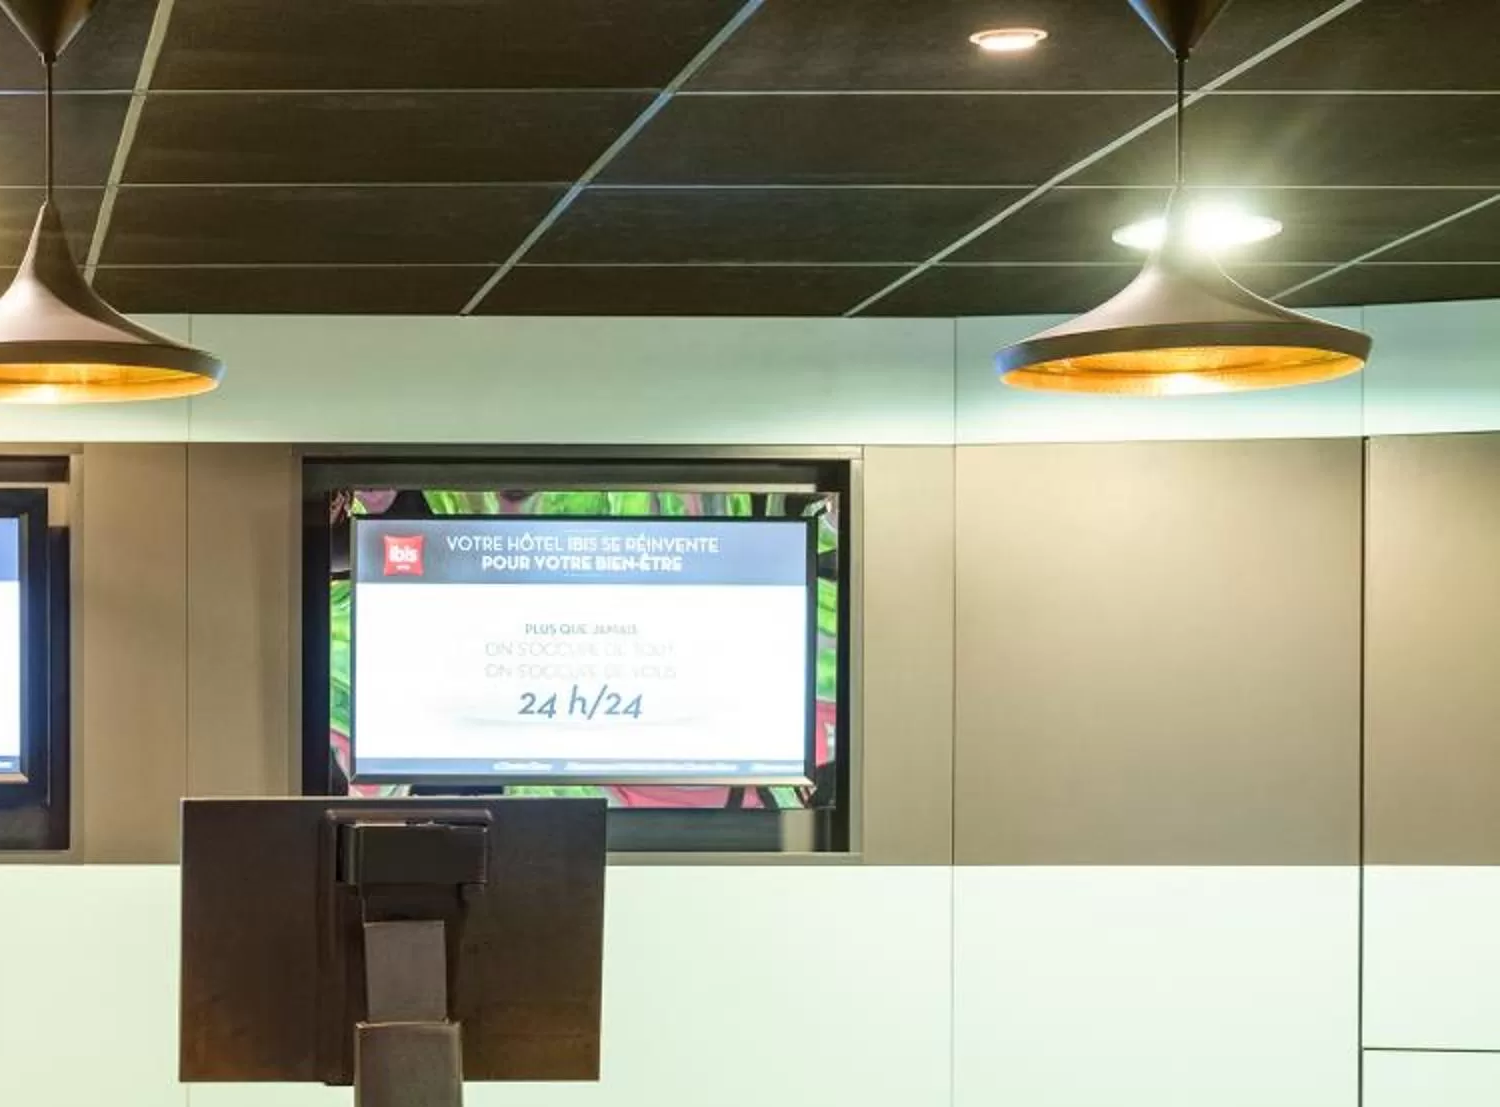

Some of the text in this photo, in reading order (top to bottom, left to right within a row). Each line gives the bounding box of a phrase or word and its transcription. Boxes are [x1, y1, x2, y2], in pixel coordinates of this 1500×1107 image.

[446, 532, 720, 553] VOTRE HÔTEL IBIS SE RÉINVENTE
[389, 544, 418, 563] ibis
[481, 552, 683, 571] POUR VOTRE BIEN-ÊTRE
[525, 623, 556, 636] PLUS
[517, 684, 643, 720] 24 h/24
